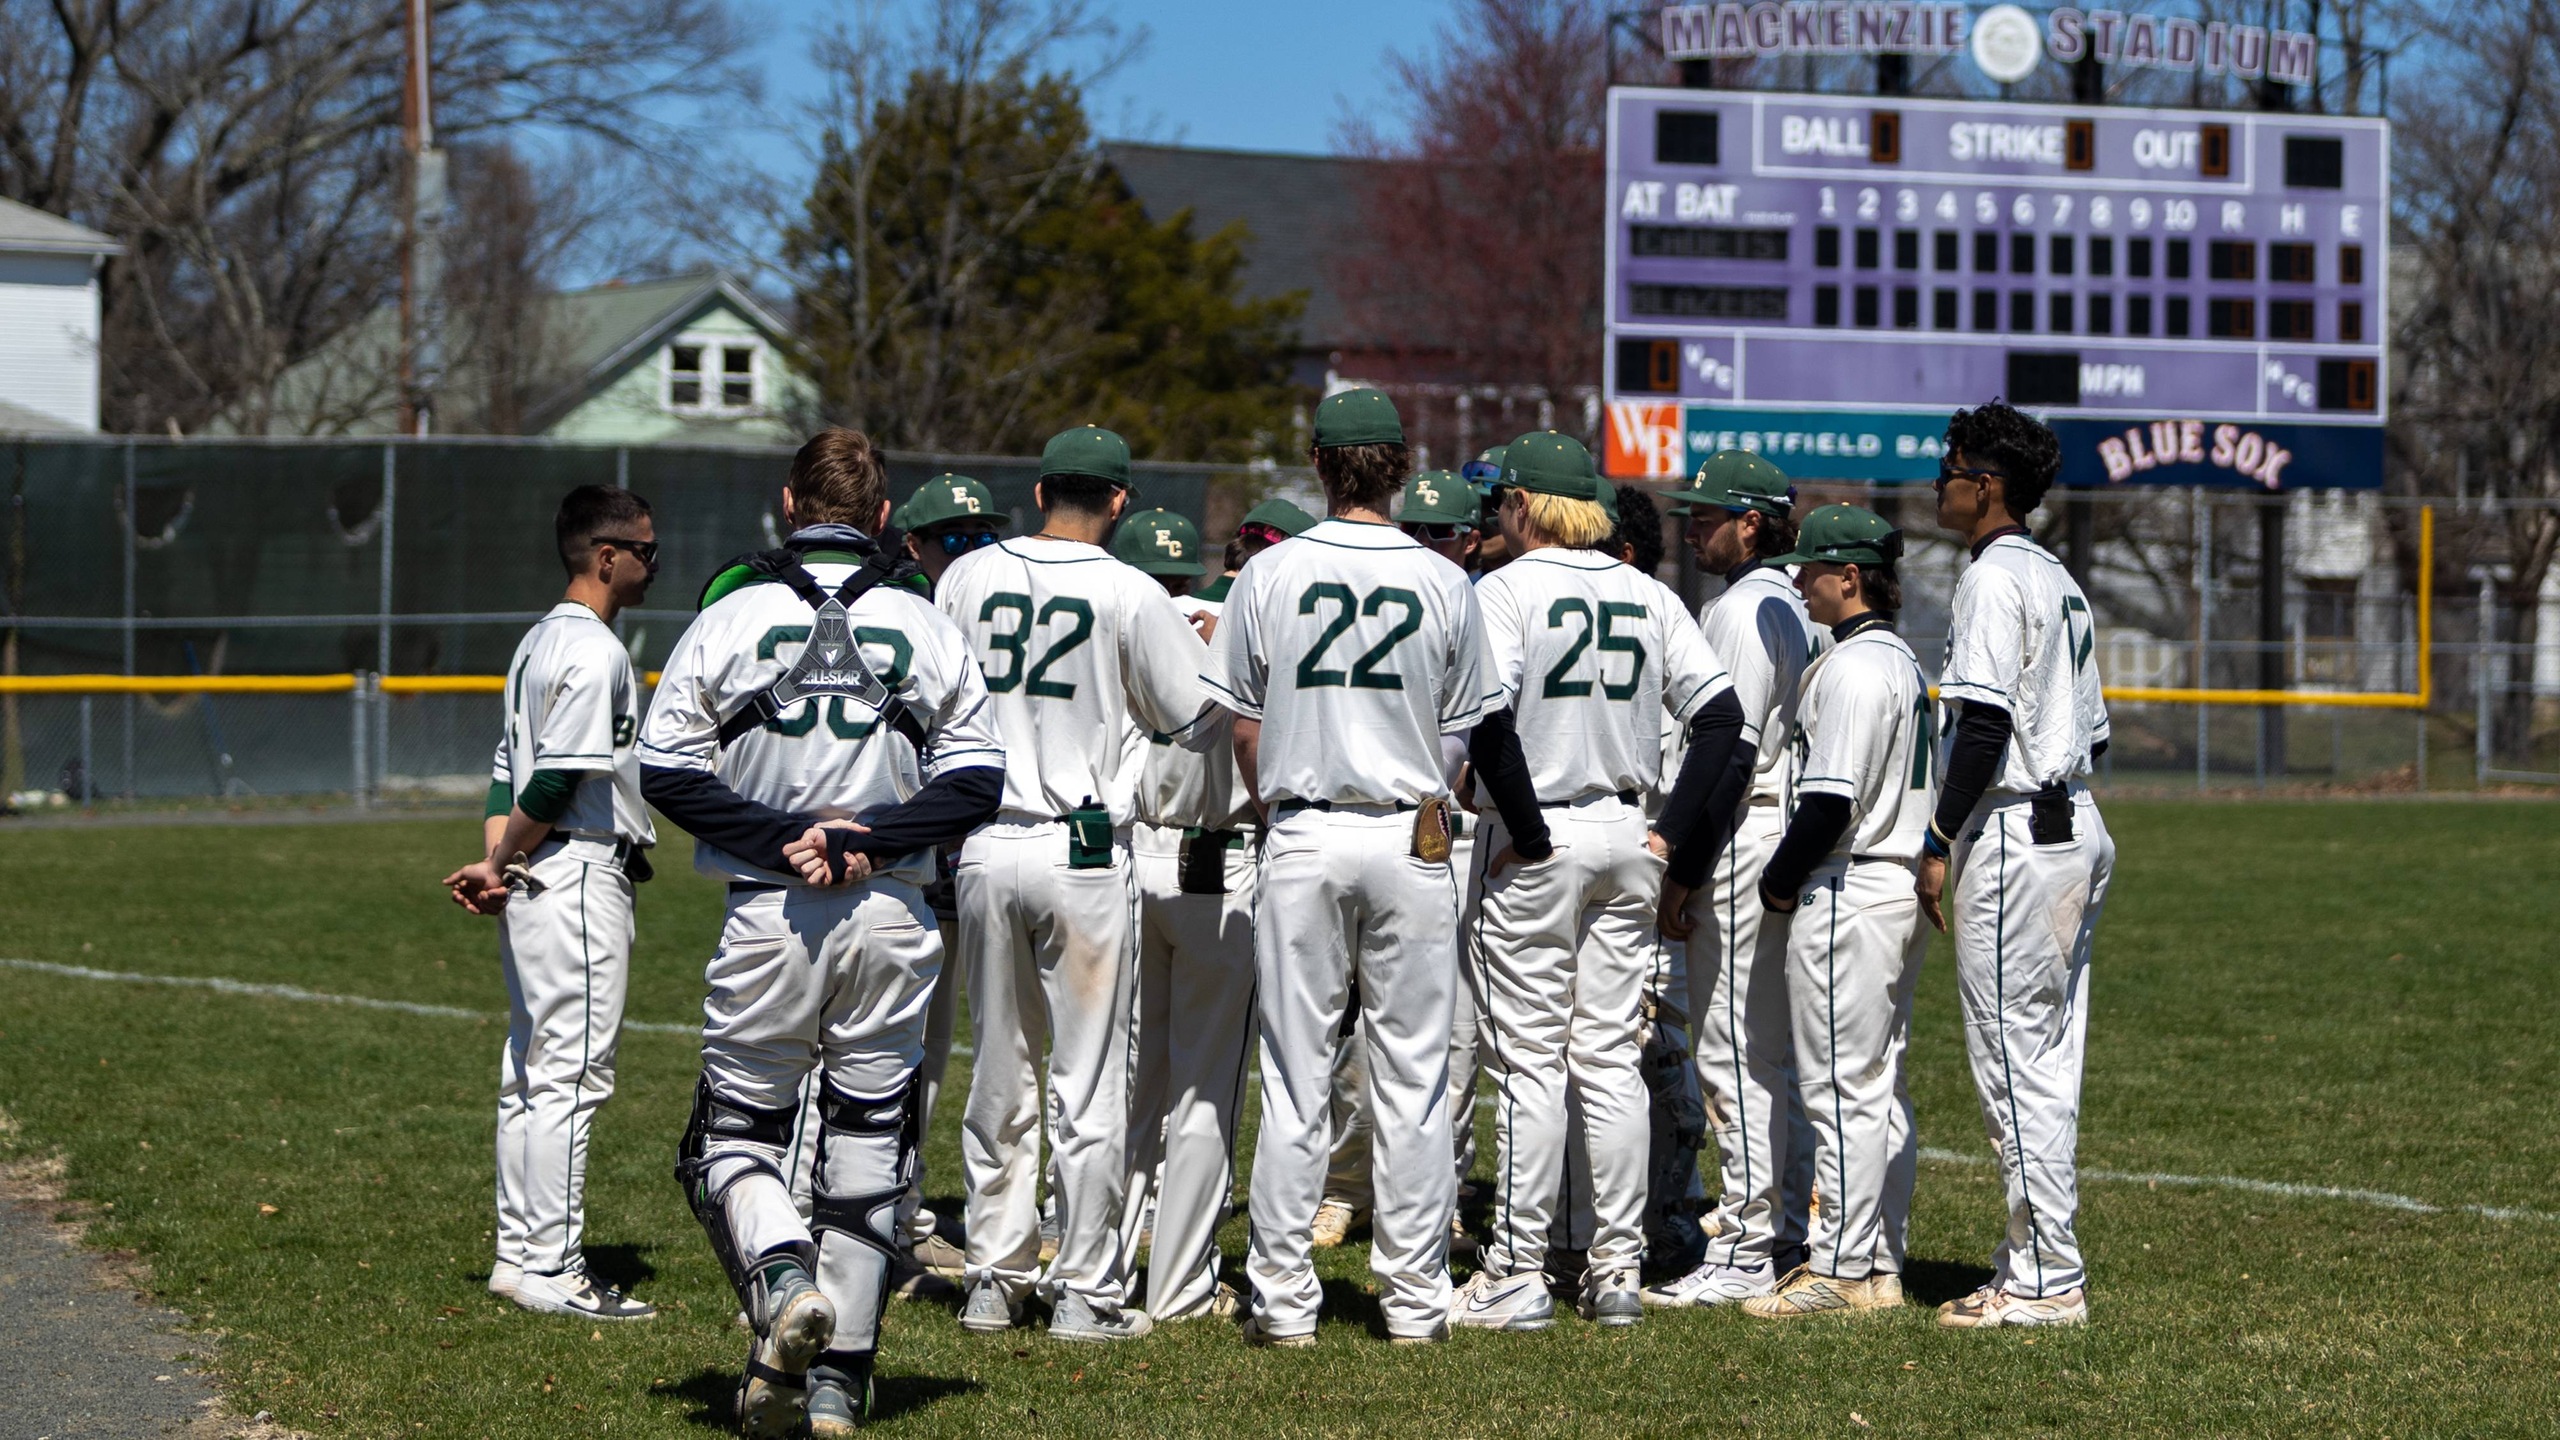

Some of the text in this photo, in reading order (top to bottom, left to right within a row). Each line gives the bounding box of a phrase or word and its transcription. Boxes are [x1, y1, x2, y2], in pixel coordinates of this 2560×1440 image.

[1661, 1, 2317, 86] MACKENZIE STADIUM
[1781, 115, 1869, 156] BALL
[1949, 121, 2065, 164] STRIKE
[2133, 128, 2200, 169] OUT
[1621, 181, 1741, 222] AT BAT
[1818, 186, 1838, 219] 1
[1857, 187, 1881, 221] 2
[1896, 189, 1919, 222] 3
[1935, 190, 1958, 223] 4
[1975, 191, 1998, 224] 5
[2012, 193, 2035, 226] 6
[2052, 194, 2074, 227] 7
[2090, 196, 2113, 229] 8
[2129, 197, 2152, 230] 9
[2163, 198, 2197, 231] 10
[2221, 200, 2245, 233] R
[2280, 203, 2306, 235] H
[2340, 204, 2362, 237] E
[2079, 362, 2145, 397] MPH
[1609, 402, 1684, 479] WB
[1688, 430, 1950, 458] WESTFIELD BA
[2098, 420, 2292, 490] BLUE SOX
[952, 486, 981, 513] EC
[1415, 480, 1440, 505] EC
[1155, 529, 1182, 557] EC
[977, 592, 1096, 700] 32
[1297, 582, 1424, 691] 22
[1542, 597, 1648, 701] 25
[801, 669, 861, 685] ALL-STAR
